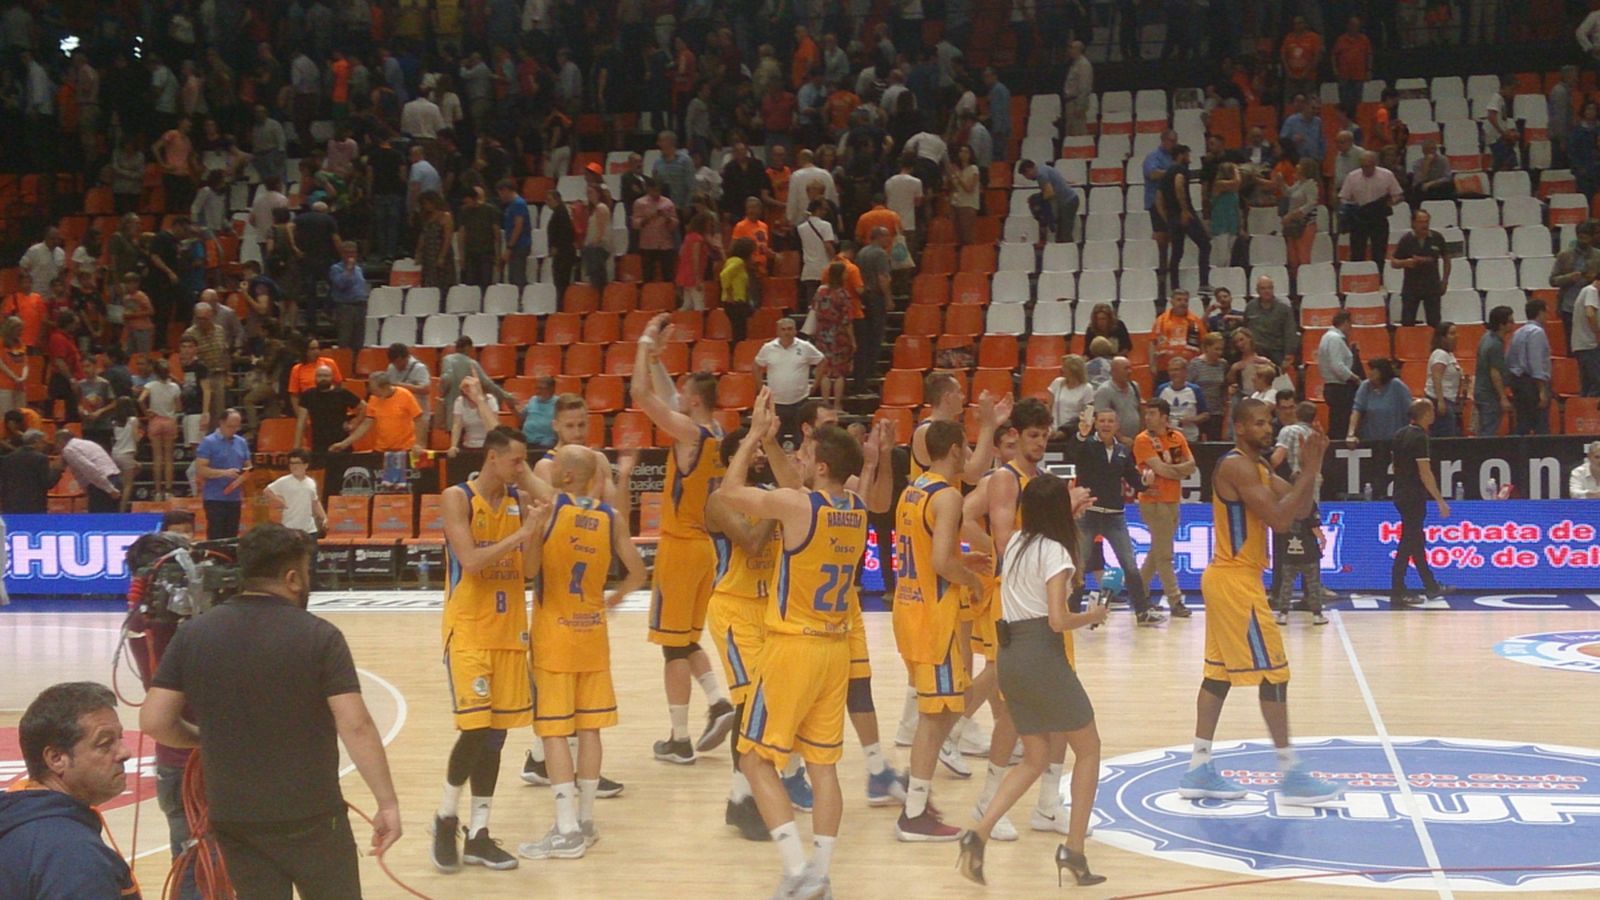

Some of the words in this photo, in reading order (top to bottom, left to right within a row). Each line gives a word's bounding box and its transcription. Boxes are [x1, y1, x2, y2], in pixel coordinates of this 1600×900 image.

[1549, 519, 1596, 542] de
[1491, 548, 1540, 567] de
[568, 561, 588, 602] 4
[813, 563, 855, 612] 22
[495, 591, 507, 614] 8
